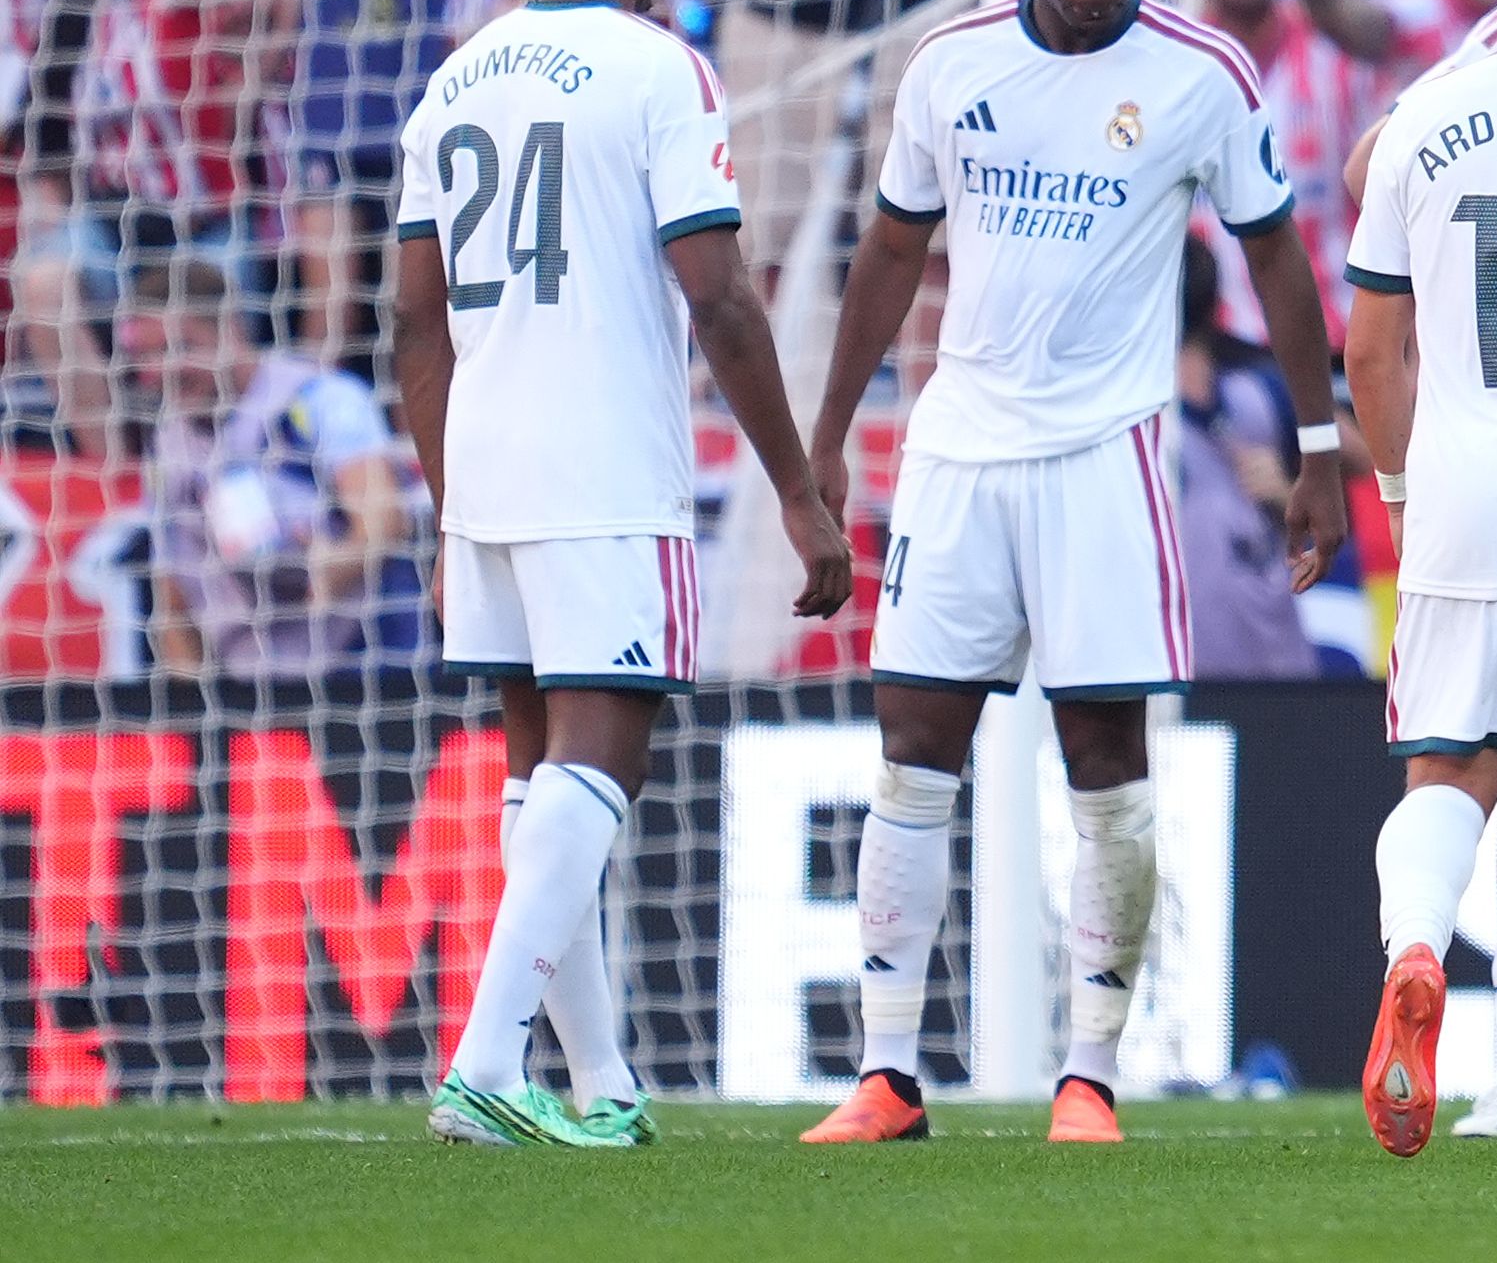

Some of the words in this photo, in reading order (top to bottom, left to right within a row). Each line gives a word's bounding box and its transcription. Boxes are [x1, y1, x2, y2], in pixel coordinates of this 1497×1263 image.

[442, 42, 593, 107] DUMFRIES
[961, 156, 1130, 208] Emirates
[437, 121, 569, 312] 24
[977, 202, 1009, 236] FLY
[1010, 206, 1095, 243] BETTER
